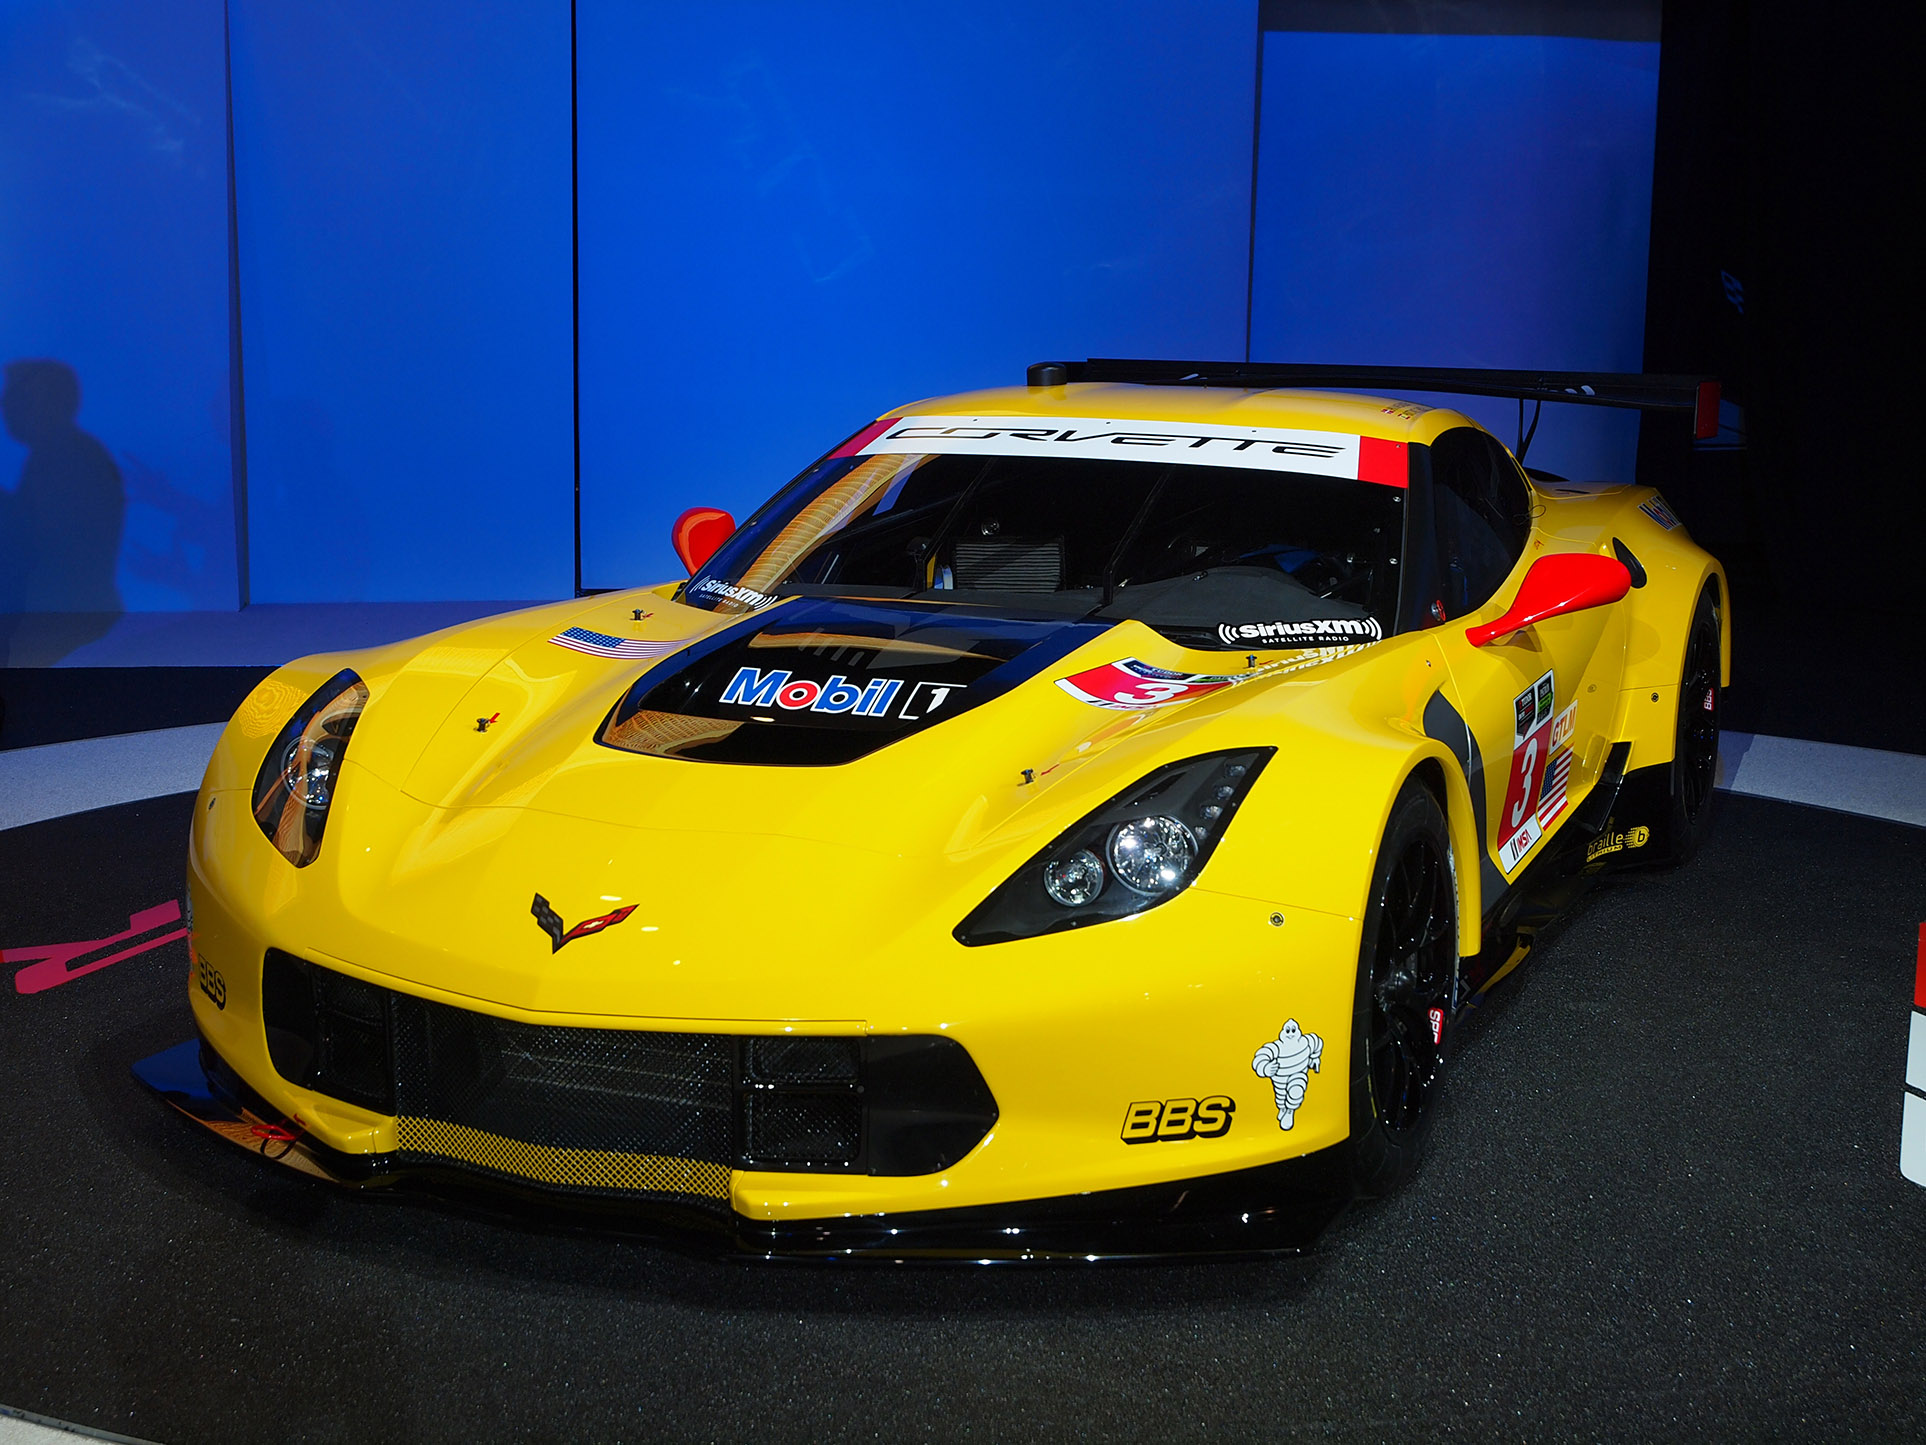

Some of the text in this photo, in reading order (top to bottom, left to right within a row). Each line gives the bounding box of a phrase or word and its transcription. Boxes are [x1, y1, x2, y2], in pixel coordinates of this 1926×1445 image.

[885, 426, 1346, 459] CORVETTE
[722, 599, 739, 608] RADIO
[1262, 636, 1315, 644] SATELLITE
[719, 666, 905, 717] Mobil
[1114, 683, 1190, 704] 3
[1552, 705, 1577, 748] GTLM
[1511, 737, 1538, 828] 3
[1587, 831, 1624, 856] braille
[198, 952, 227, 1011] BBS
[1120, 1094, 1236, 1146] BBS
